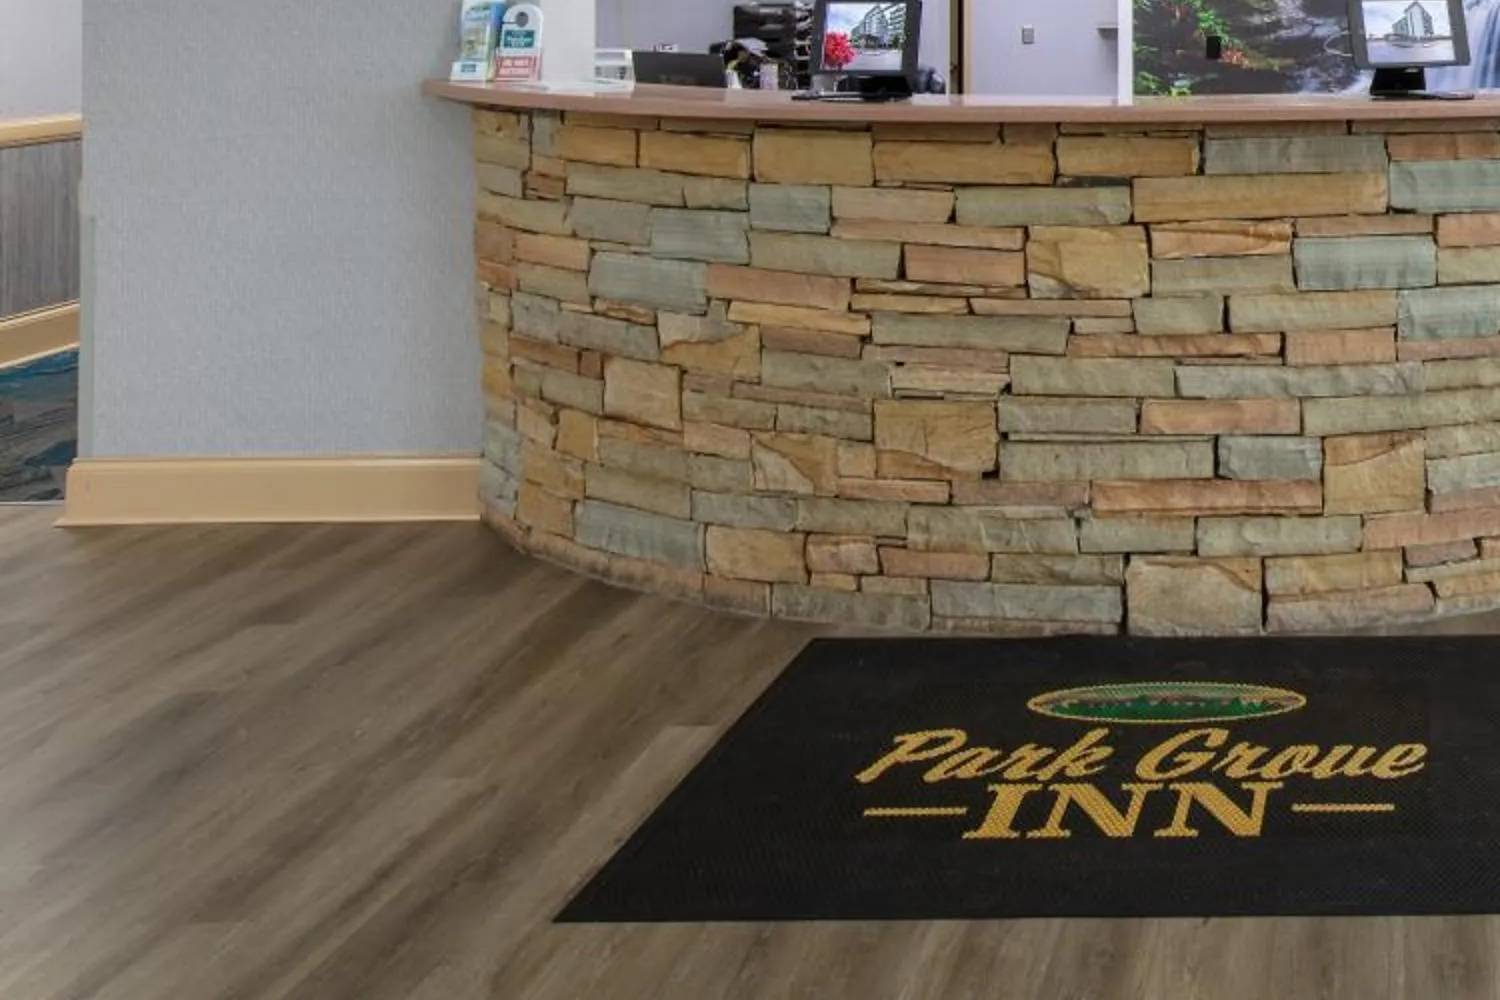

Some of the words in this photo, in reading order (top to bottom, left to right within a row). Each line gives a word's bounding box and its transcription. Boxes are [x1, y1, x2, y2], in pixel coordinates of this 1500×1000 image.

[855, 727, 1113, 783] Park
[1134, 727, 1428, 782] Grove
[962, 782, 1285, 839] INN
